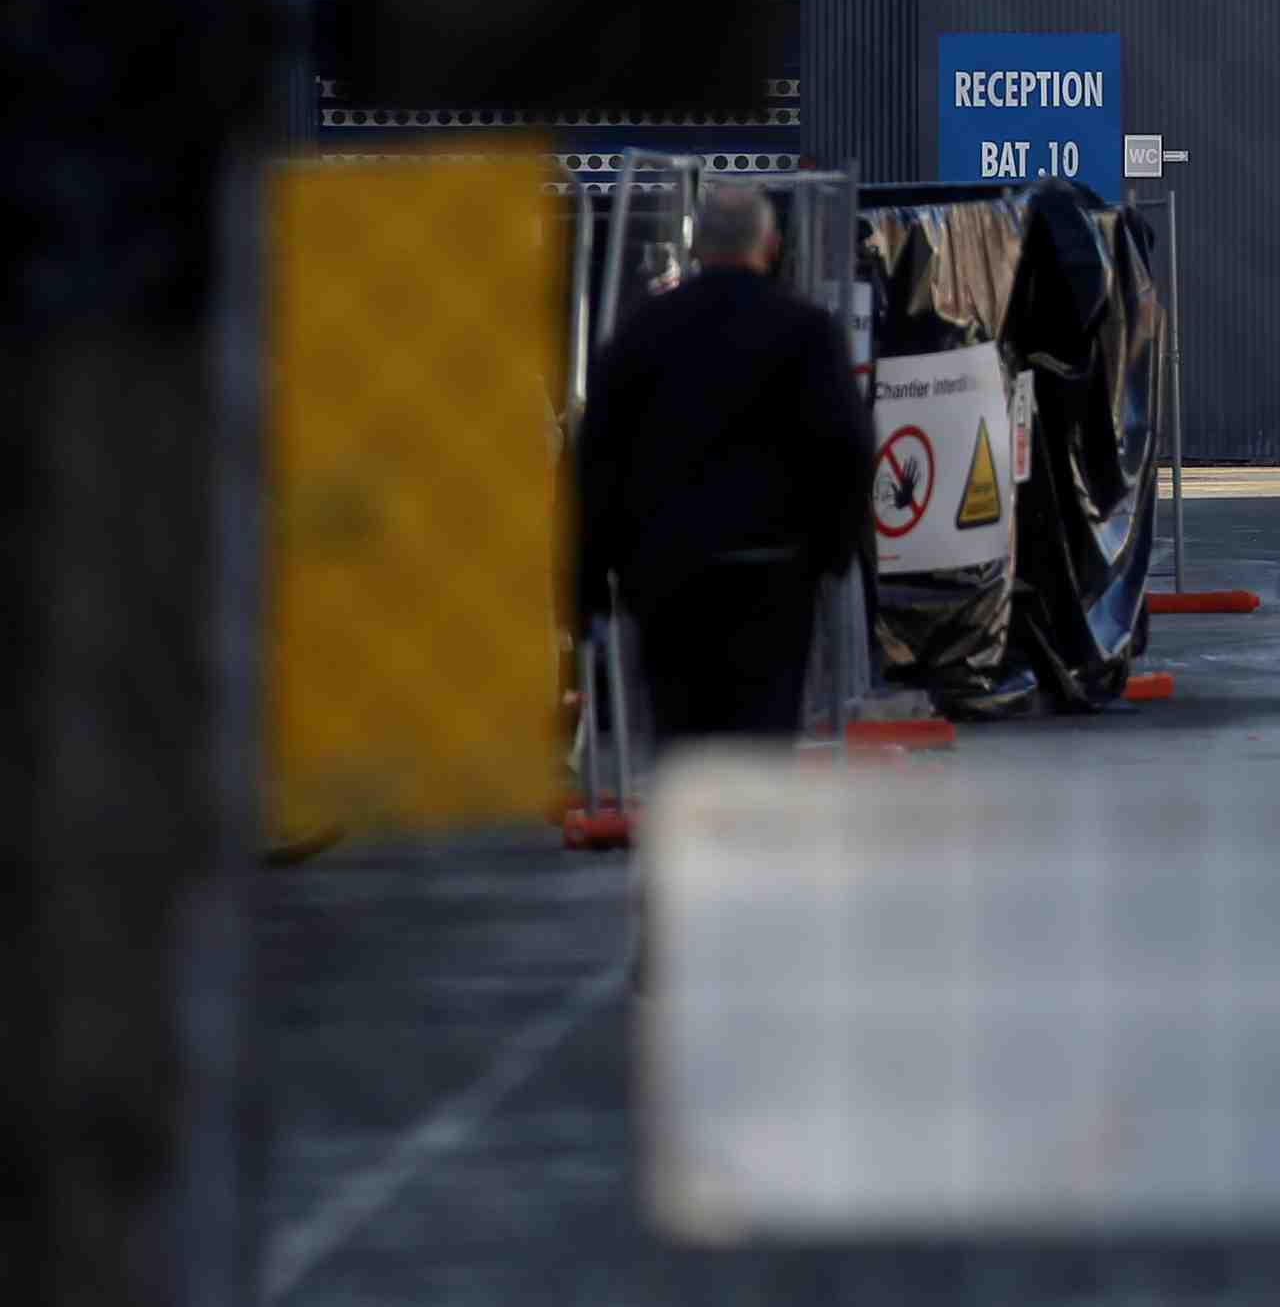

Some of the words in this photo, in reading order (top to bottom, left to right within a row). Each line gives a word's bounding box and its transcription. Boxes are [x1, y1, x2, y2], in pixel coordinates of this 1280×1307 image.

[955, 71, 1103, 107] RECEPTION
[981, 141, 1031, 178] BAT
[1129, 148, 1158, 165] WC
